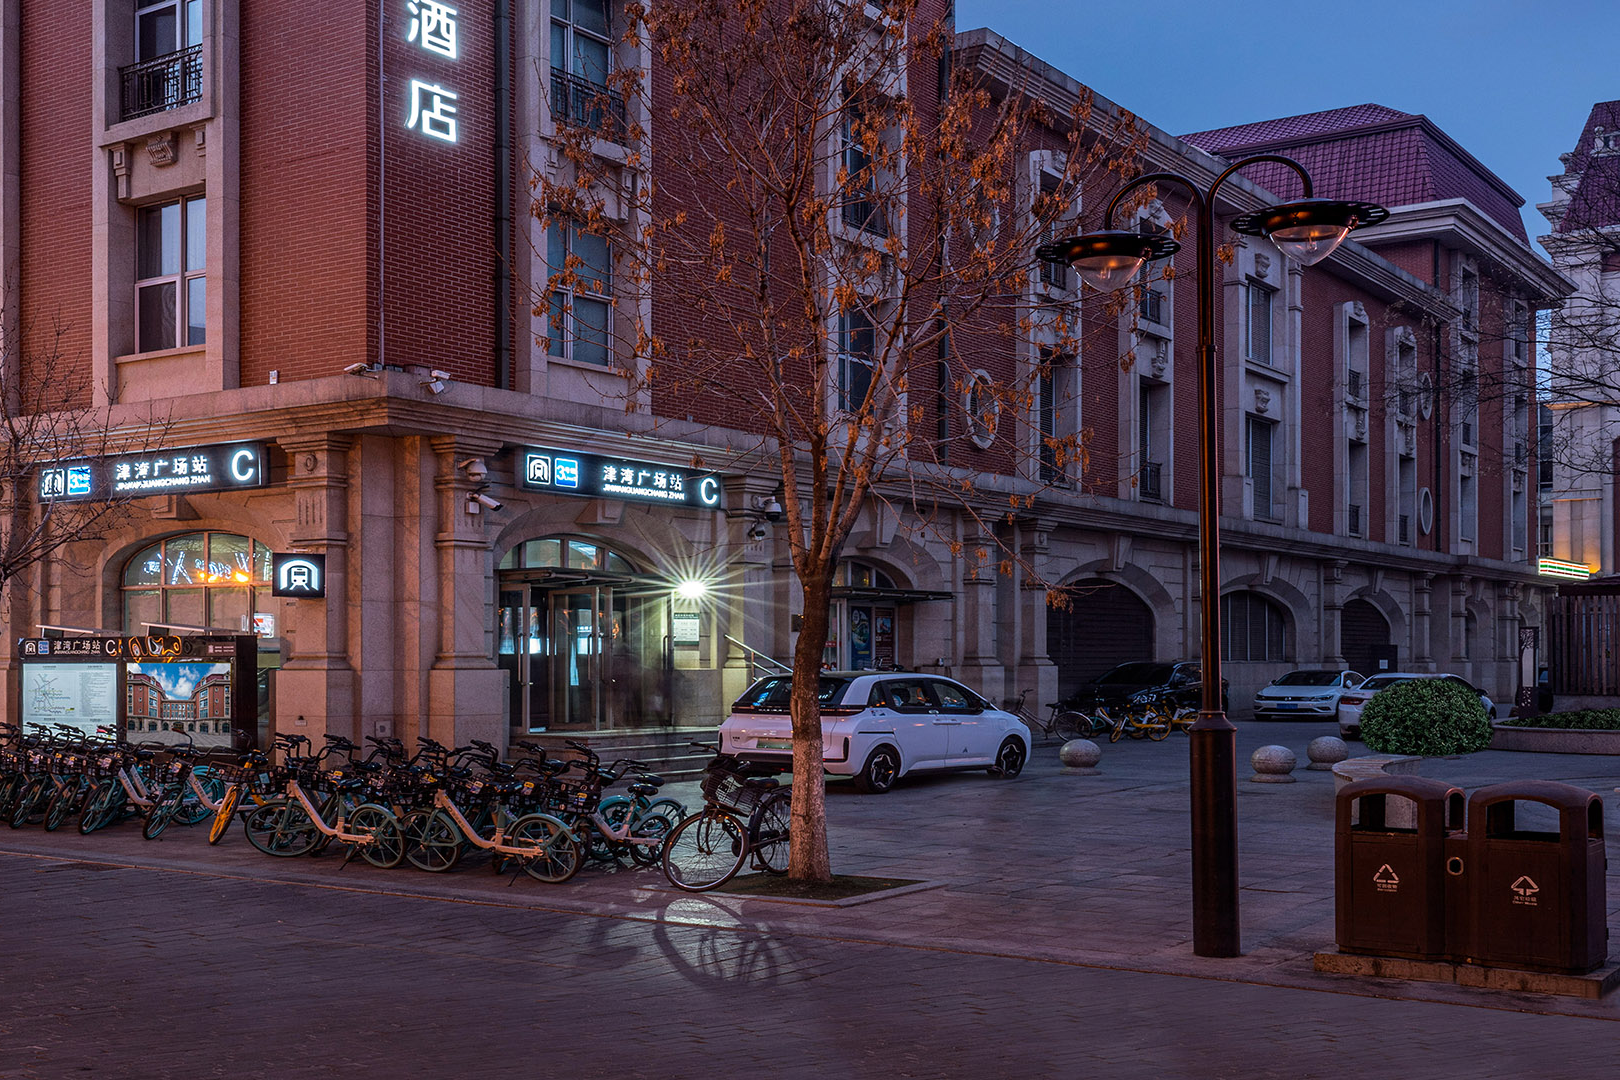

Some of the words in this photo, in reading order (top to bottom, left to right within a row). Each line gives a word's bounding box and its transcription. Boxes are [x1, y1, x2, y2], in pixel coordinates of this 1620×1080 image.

[115, 455, 208, 481] 津湾广场站
[231, 449, 254, 481] C
[190, 474, 211, 484] ZHAN
[603, 465, 683, 491] 津湾广场站
[668, 490, 685, 501] ZHAN
[700, 477, 718, 505] C
[53, 640, 100, 651] 津湾广场站
[105, 639, 116, 654] C
